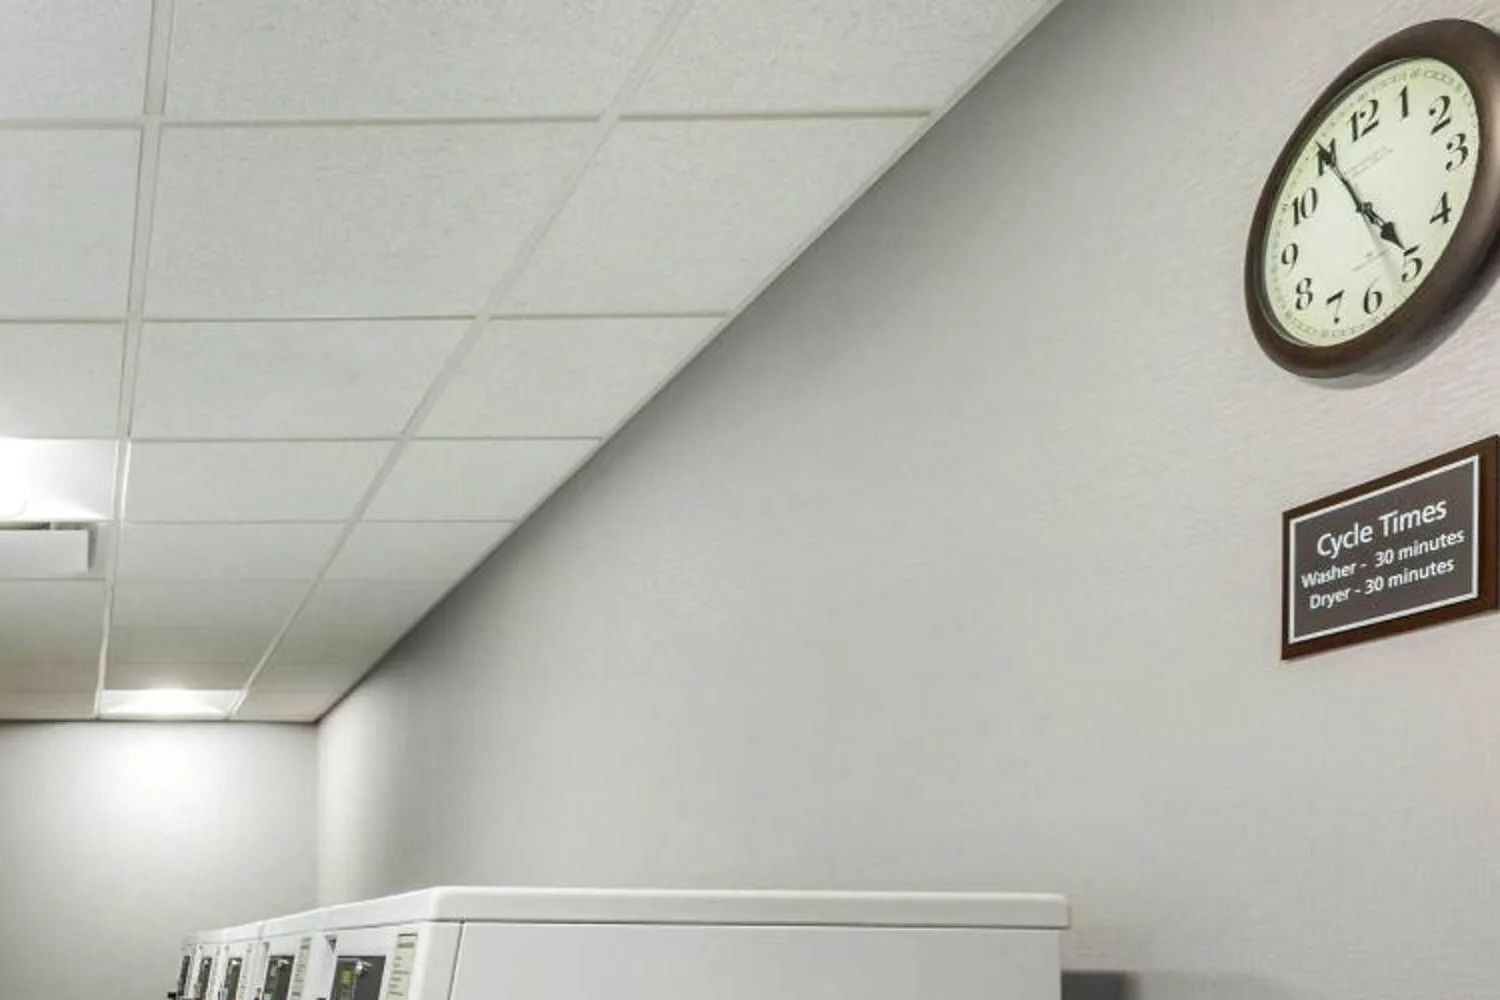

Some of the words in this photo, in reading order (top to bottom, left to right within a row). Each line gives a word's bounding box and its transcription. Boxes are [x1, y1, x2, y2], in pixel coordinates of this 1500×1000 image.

[1349, 99, 1380, 143] 12
[1399, 86, 1410, 119] 1
[1428, 95, 1452, 136] 2
[1445, 132, 1469, 172] 3
[1292, 186, 1318, 227] 10
[1429, 191, 1452, 226] 4
[1281, 242, 1299, 271] 9
[1401, 245, 1423, 283] 5
[1295, 277, 1313, 311] 8
[1326, 289, 1345, 324] 7
[1363, 275, 1383, 315] 6
[1316, 521, 1374, 559] Cycle
[1378, 500, 1448, 537] Times
[1300, 561, 1357, 588] Washer
[1374, 549, 1395, 568] 30
[1398, 529, 1466, 561] minutes
[1308, 585, 1351, 610] Dryer
[1364, 576, 1384, 595] 30
[1387, 558, 1456, 588] minutes
